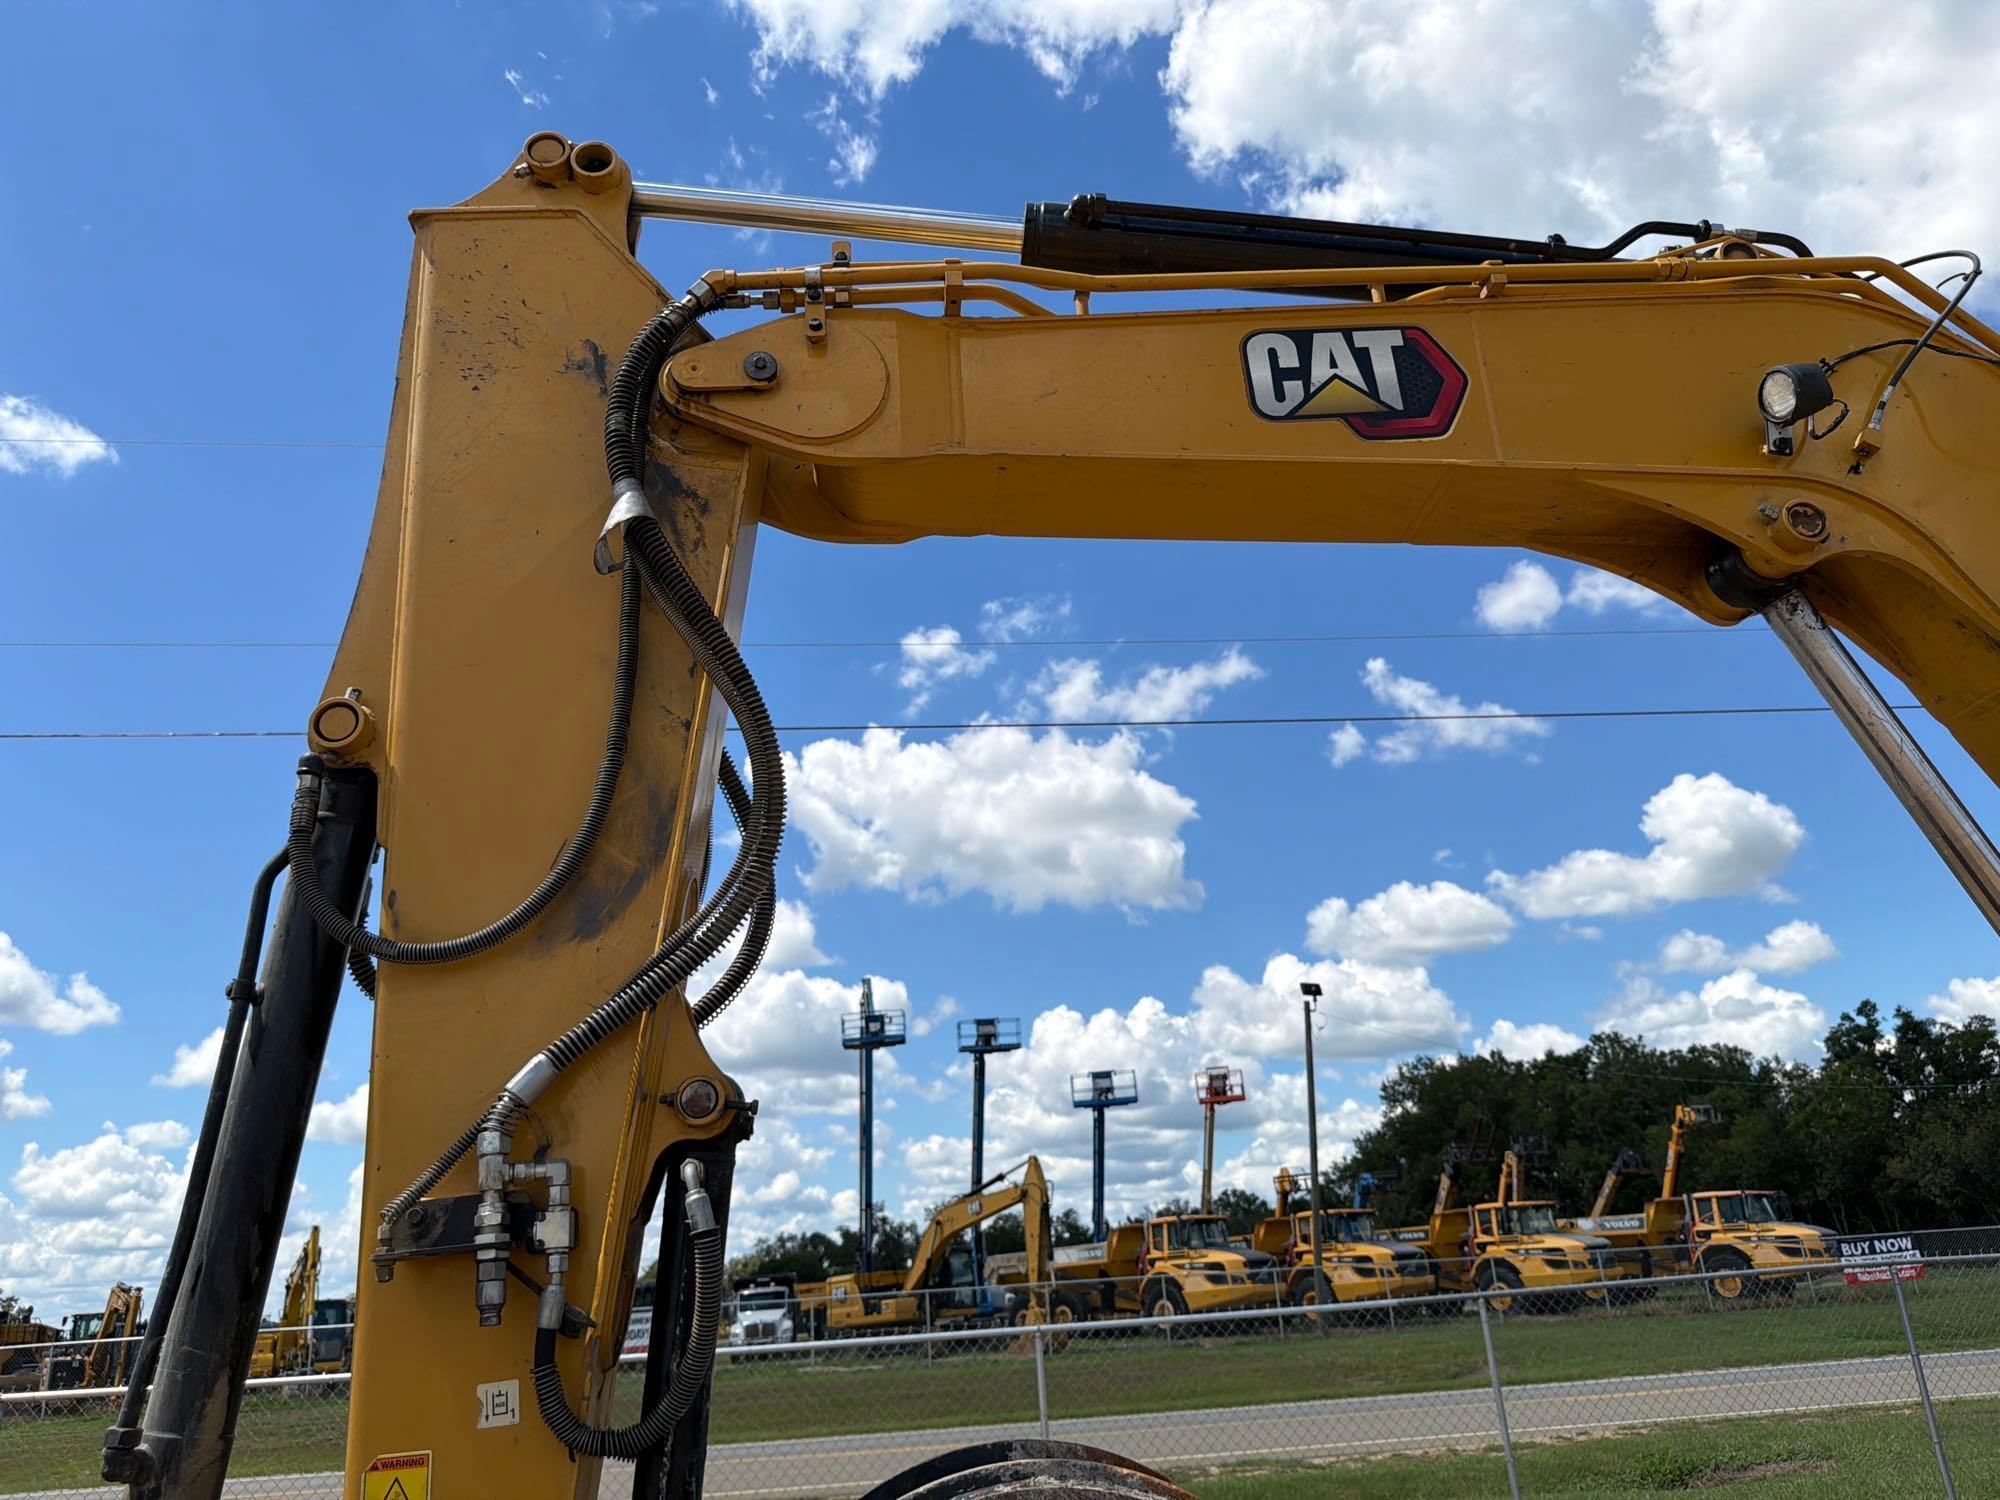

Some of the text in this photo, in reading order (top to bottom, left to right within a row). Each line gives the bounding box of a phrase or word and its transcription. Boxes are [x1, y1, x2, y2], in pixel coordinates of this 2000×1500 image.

[1246, 329, 1405, 417] CAT
[1603, 1219, 1640, 1229] VOLVO
[1840, 1236, 1913, 1256] BUY NOW
[509, 1407, 516, 1419] 1
[381, 1457, 425, 1469] WARNING
